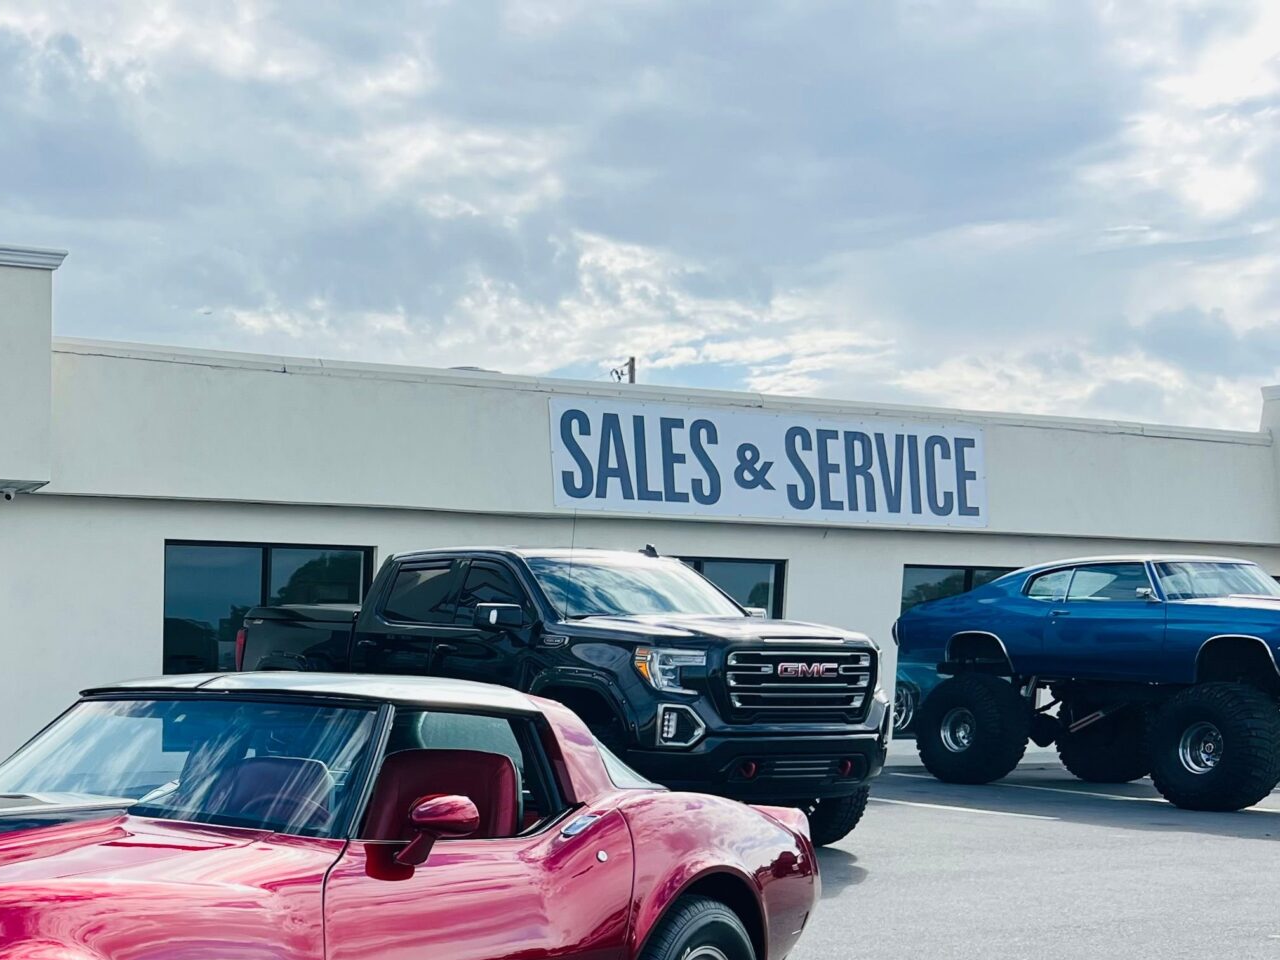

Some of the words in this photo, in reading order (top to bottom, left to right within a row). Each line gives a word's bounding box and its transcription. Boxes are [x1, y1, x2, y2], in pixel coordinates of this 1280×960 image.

[560, 409, 721, 506] SALES
[734, 443, 776, 490] &
[785, 426, 980, 516] SERVICE
[777, 662, 838, 678] GMC
